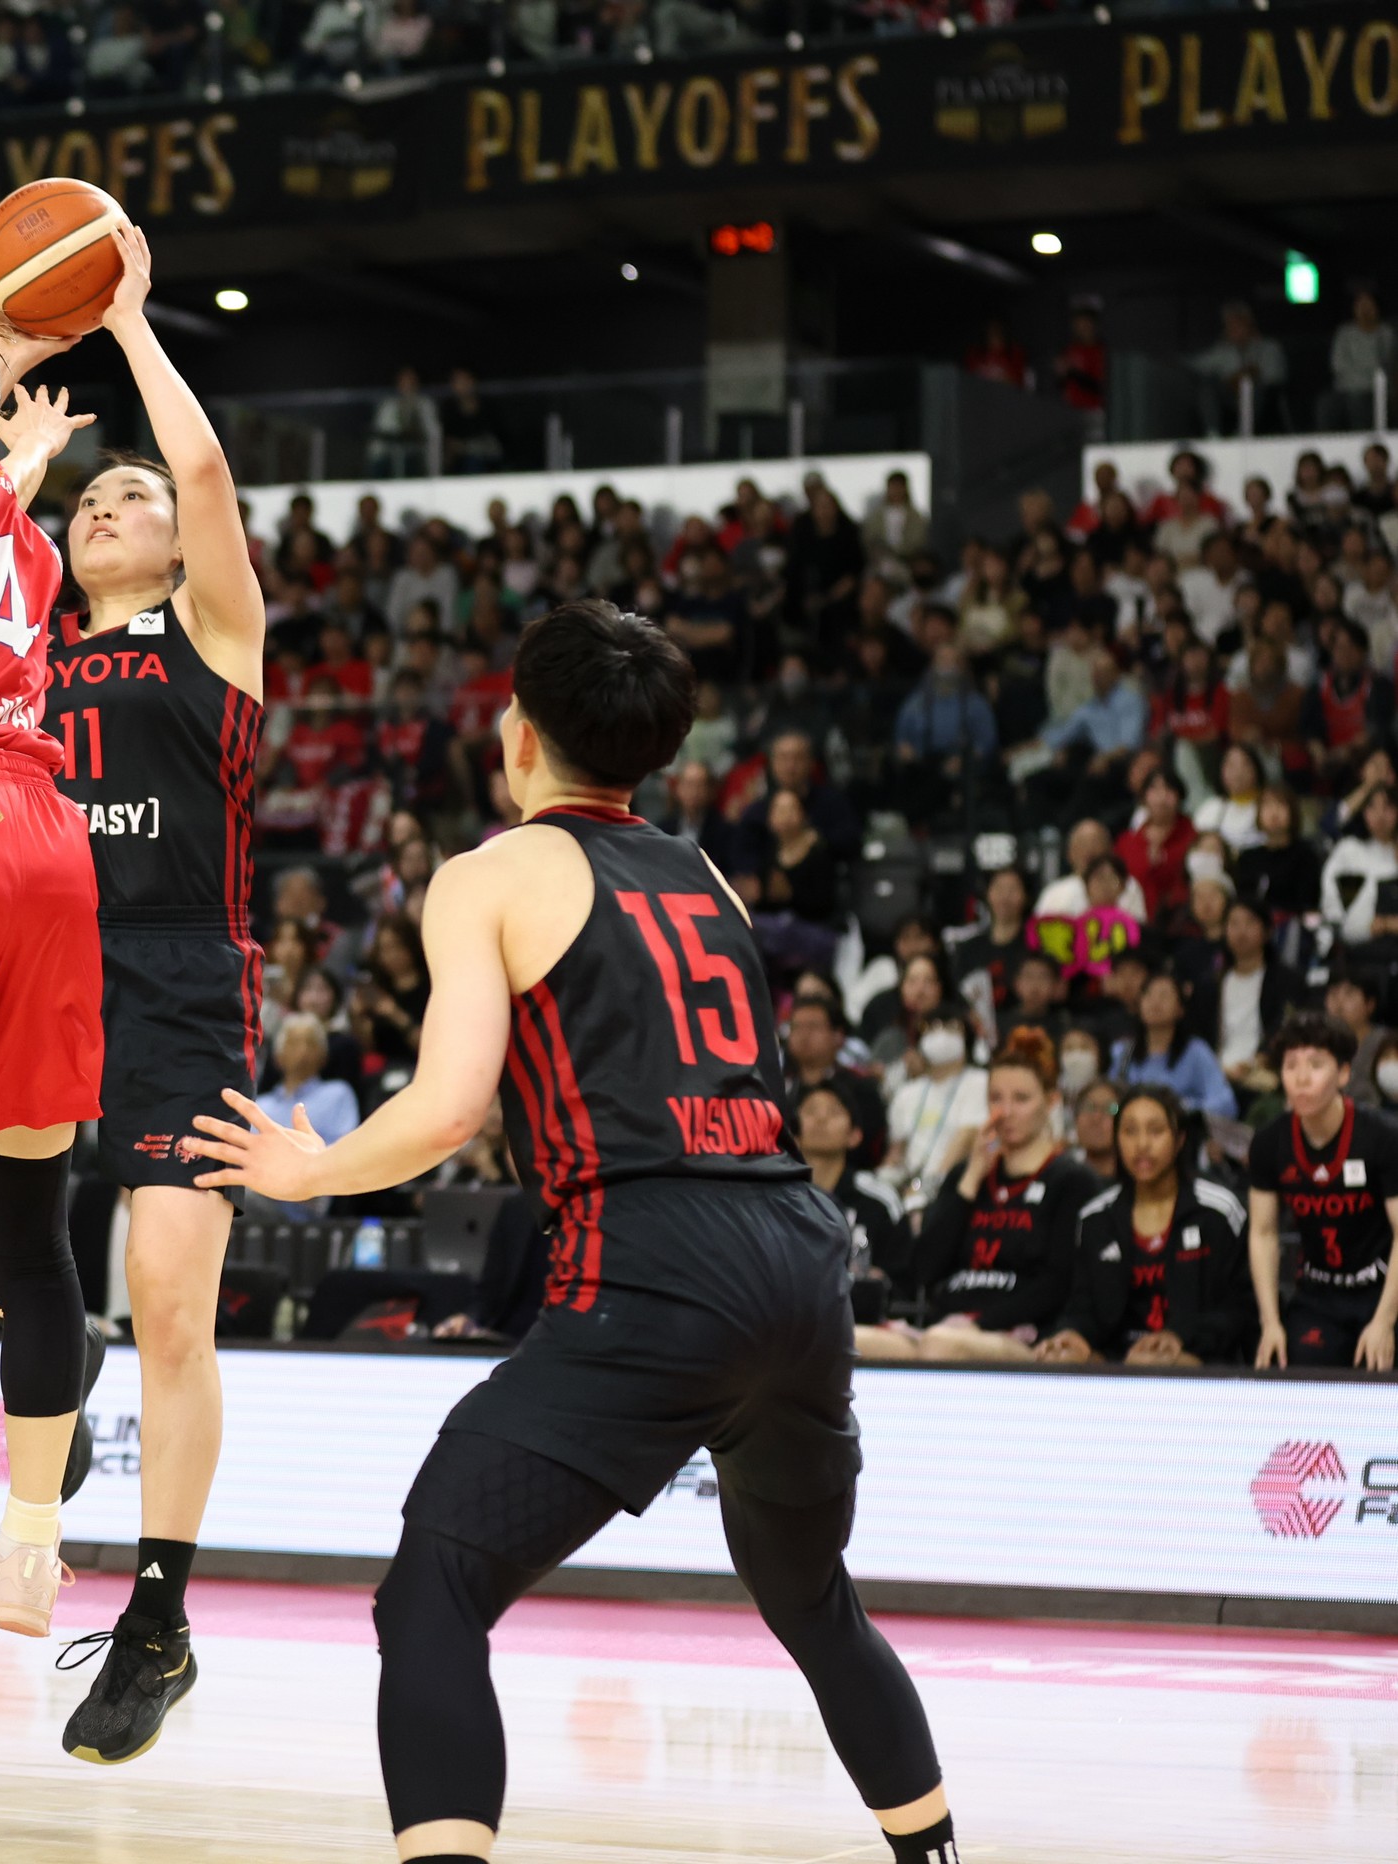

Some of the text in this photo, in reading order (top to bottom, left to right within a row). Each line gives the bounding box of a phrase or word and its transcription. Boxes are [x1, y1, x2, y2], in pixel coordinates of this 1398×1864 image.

[465, 55, 881, 192] PLAYOFFS
[16, 207, 50, 236] FIBA
[60, 707, 102, 779] 11
[77, 797, 160, 839] ASY]
[614, 889, 759, 1066] 15
[1321, 1227, 1343, 1259] 3
